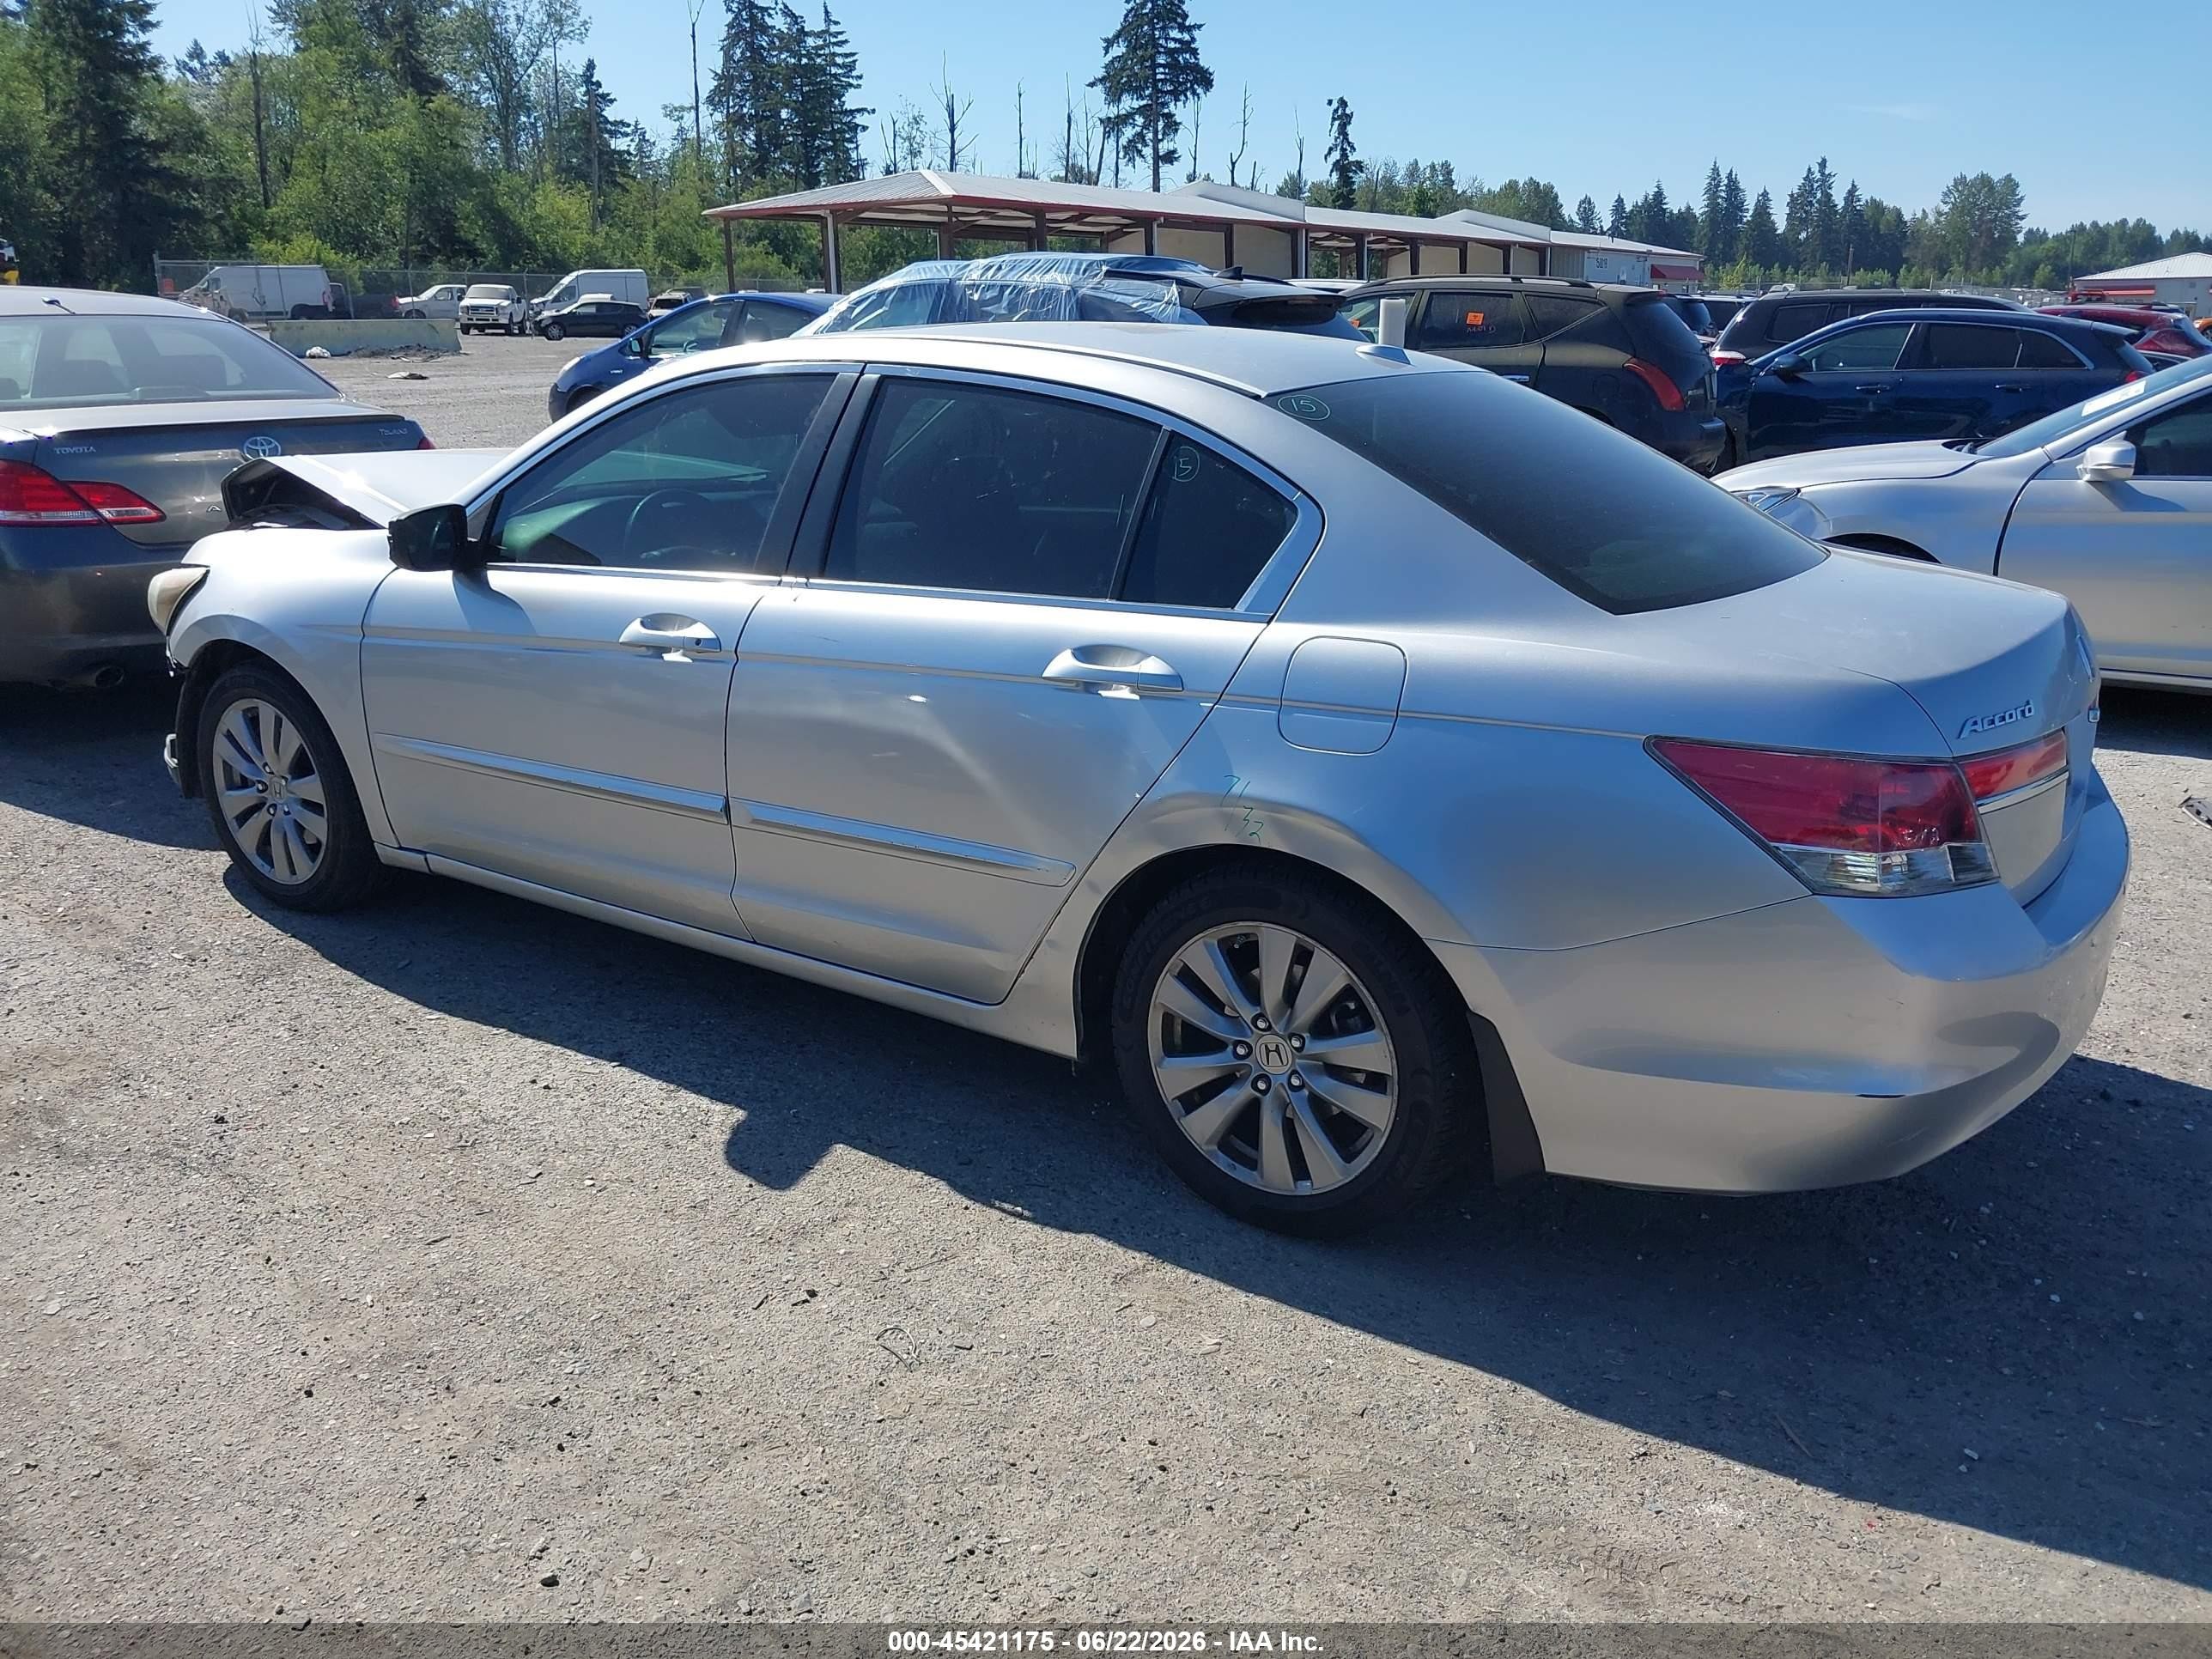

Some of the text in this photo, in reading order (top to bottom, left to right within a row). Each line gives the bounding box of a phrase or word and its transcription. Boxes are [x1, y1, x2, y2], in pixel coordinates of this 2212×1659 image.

[1291, 398, 1316, 412] 15
[54, 446, 97, 454] TOYOTA
[1957, 698, 2035, 739] Accord
